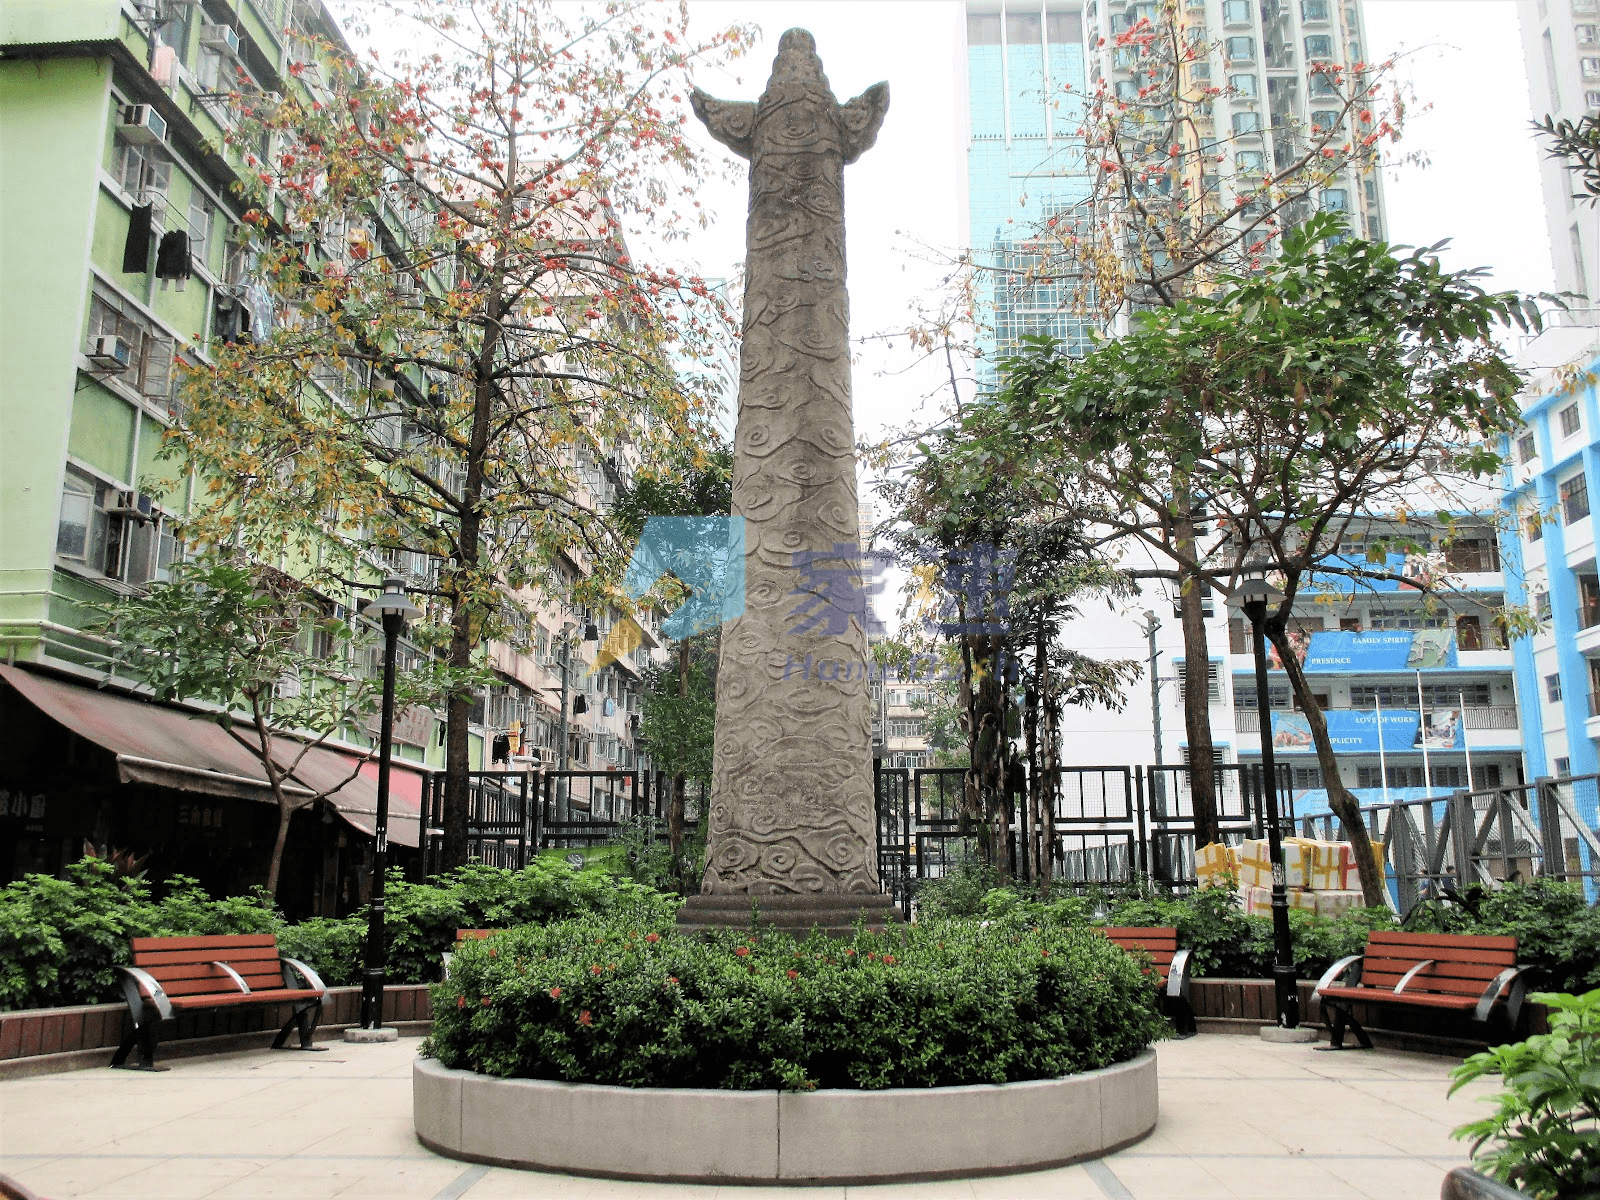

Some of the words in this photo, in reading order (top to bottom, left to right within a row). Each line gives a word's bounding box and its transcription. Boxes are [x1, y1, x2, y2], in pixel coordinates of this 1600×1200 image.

[1352, 636, 1381, 644] FAMILY
[1382, 636, 1408, 644] SPIRIT
[1311, 657, 1351, 665] PRESENCE
